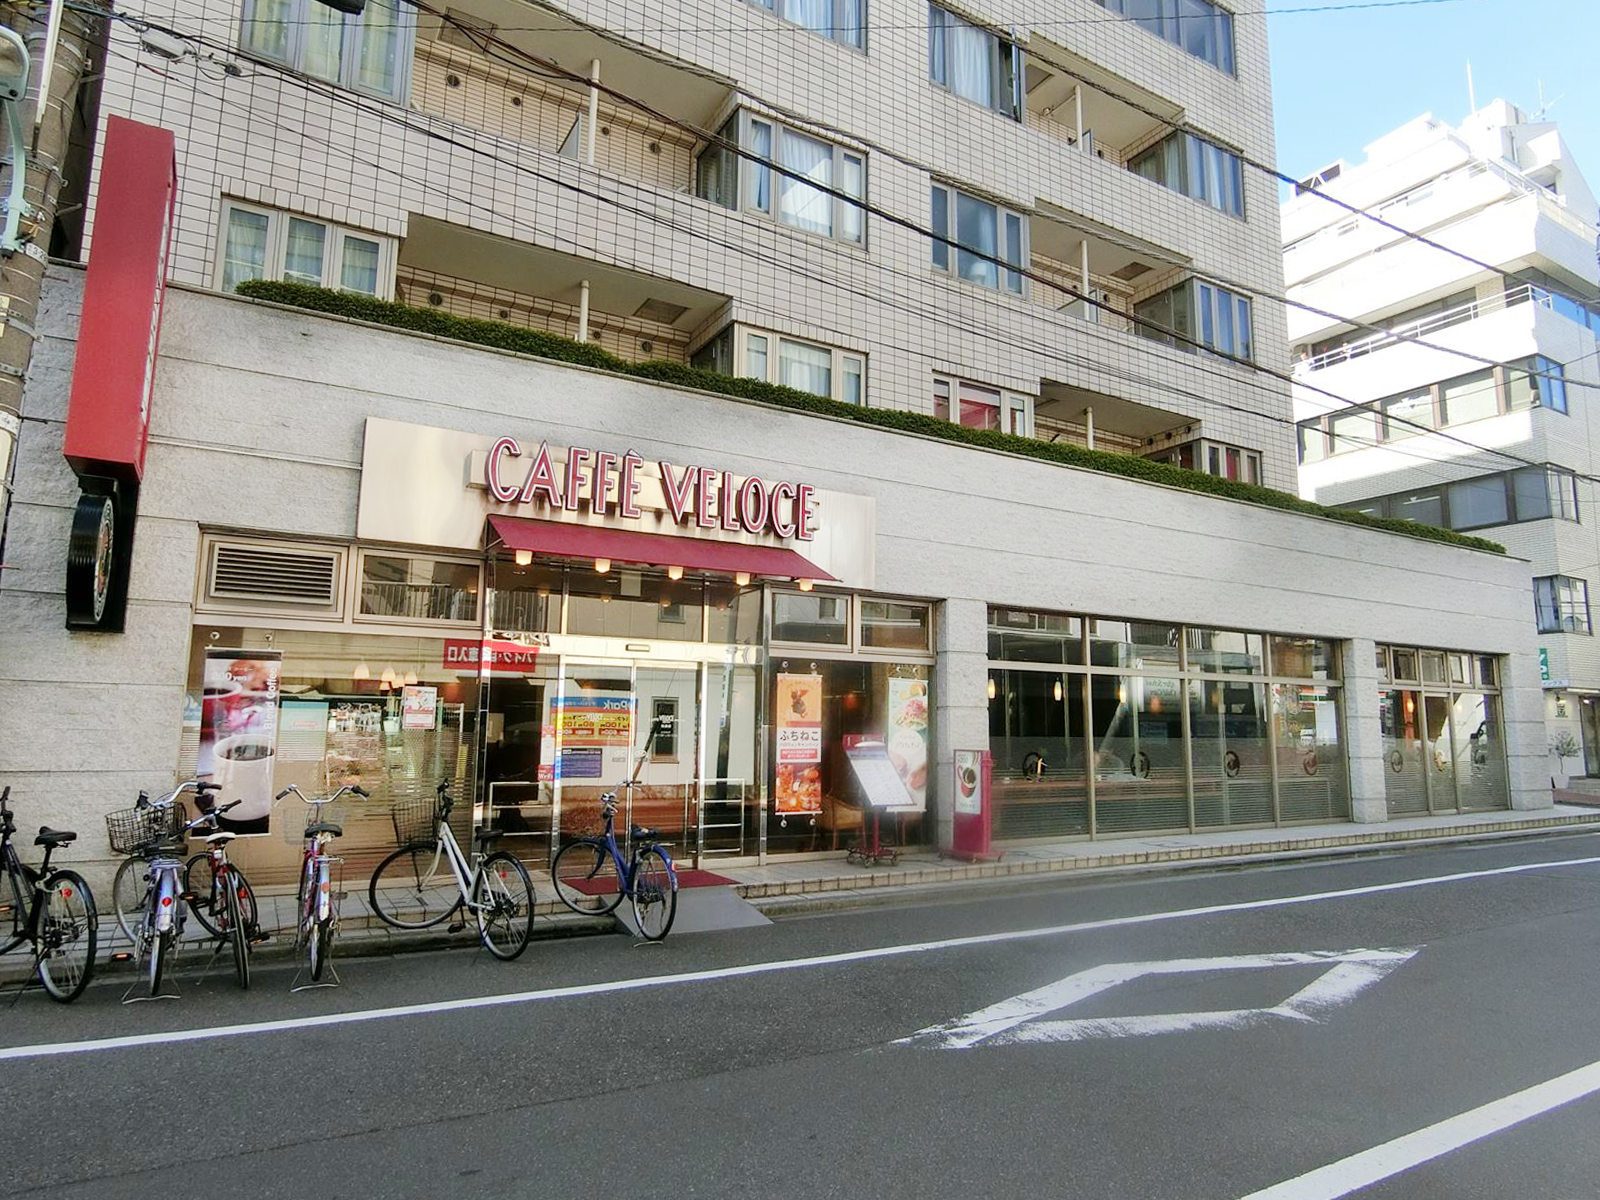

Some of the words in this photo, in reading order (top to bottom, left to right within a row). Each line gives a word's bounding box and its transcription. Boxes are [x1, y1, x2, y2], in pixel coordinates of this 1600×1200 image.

[485, 436, 643, 518] CAFFÈ
[658, 461, 816, 541] VELOCE
[266, 667, 278, 699] Coffee
[263, 701, 275, 730] Blend
[780, 730, 819, 741] ふちねこ
